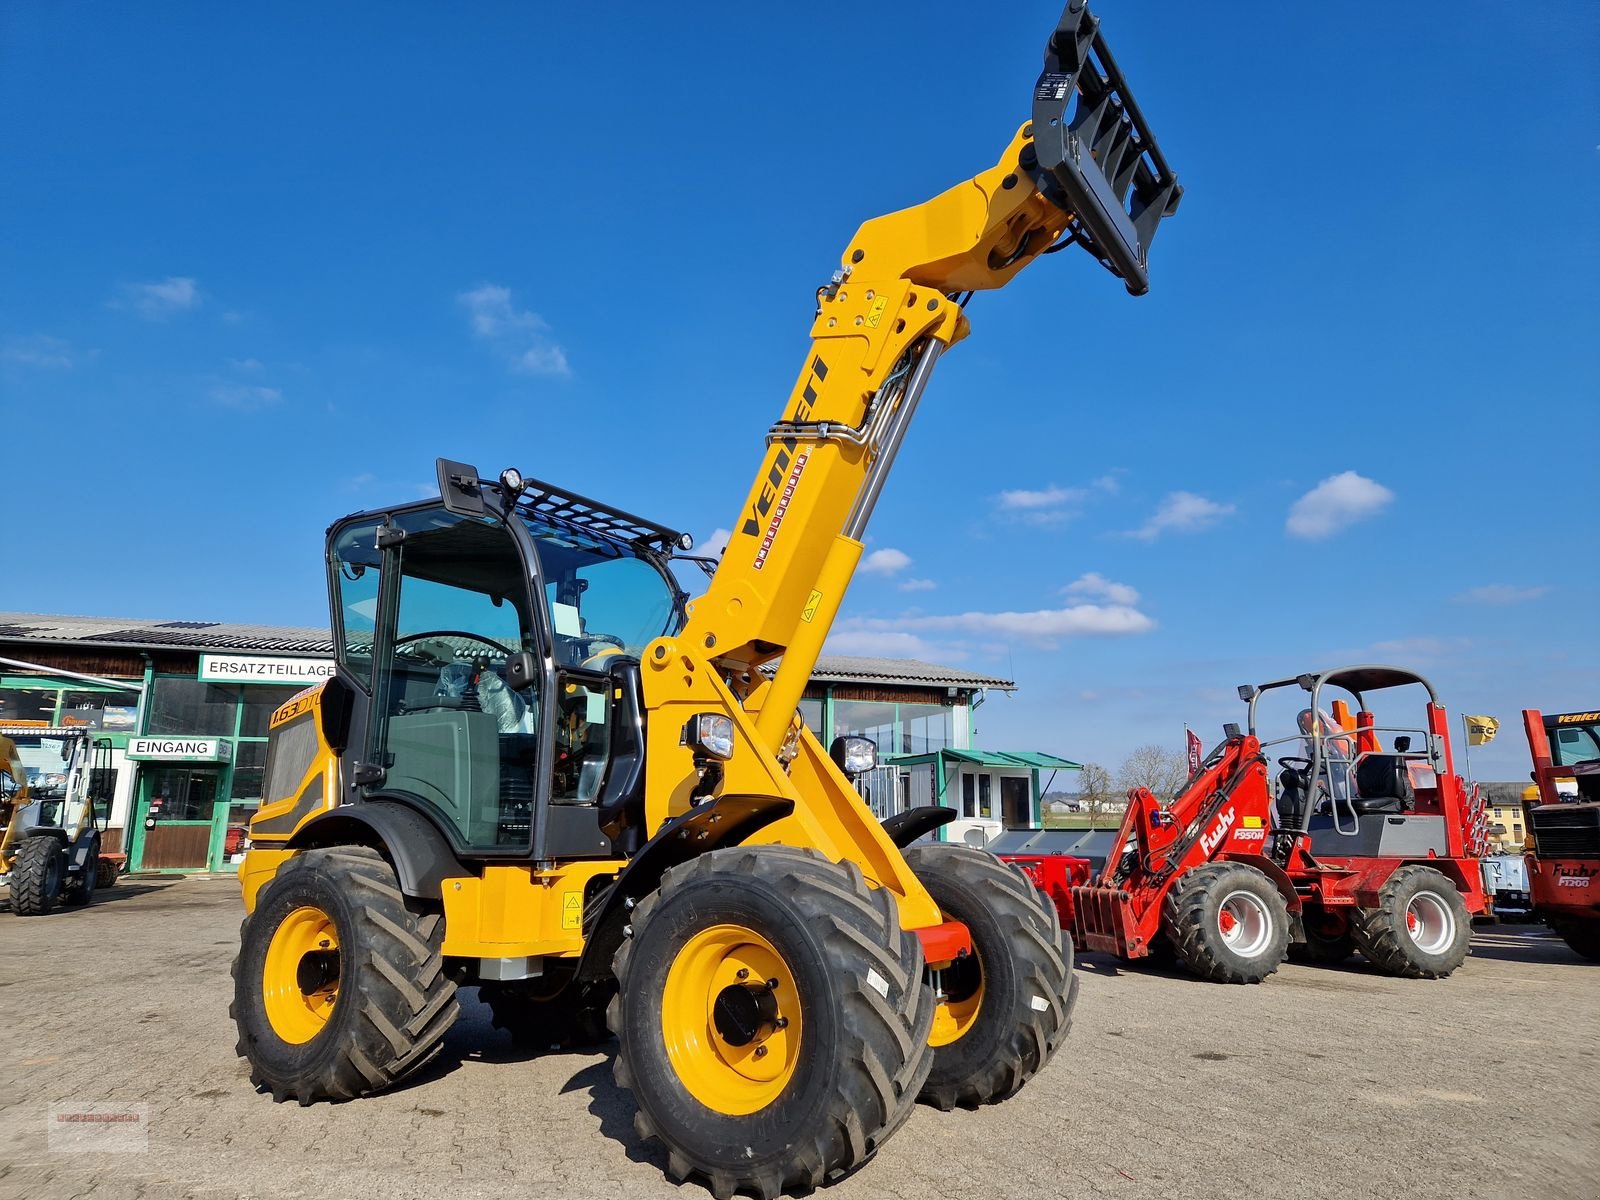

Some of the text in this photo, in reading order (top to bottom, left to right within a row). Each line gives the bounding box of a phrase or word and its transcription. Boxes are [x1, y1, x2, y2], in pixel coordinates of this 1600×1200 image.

[753, 454, 808, 570] AMSELGRUBER
[136, 741, 208, 754] EINGANG
[1200, 806, 1235, 857] Fuchs
[1233, 828, 1265, 840] F950H
[1558, 876, 1591, 888] F1200
